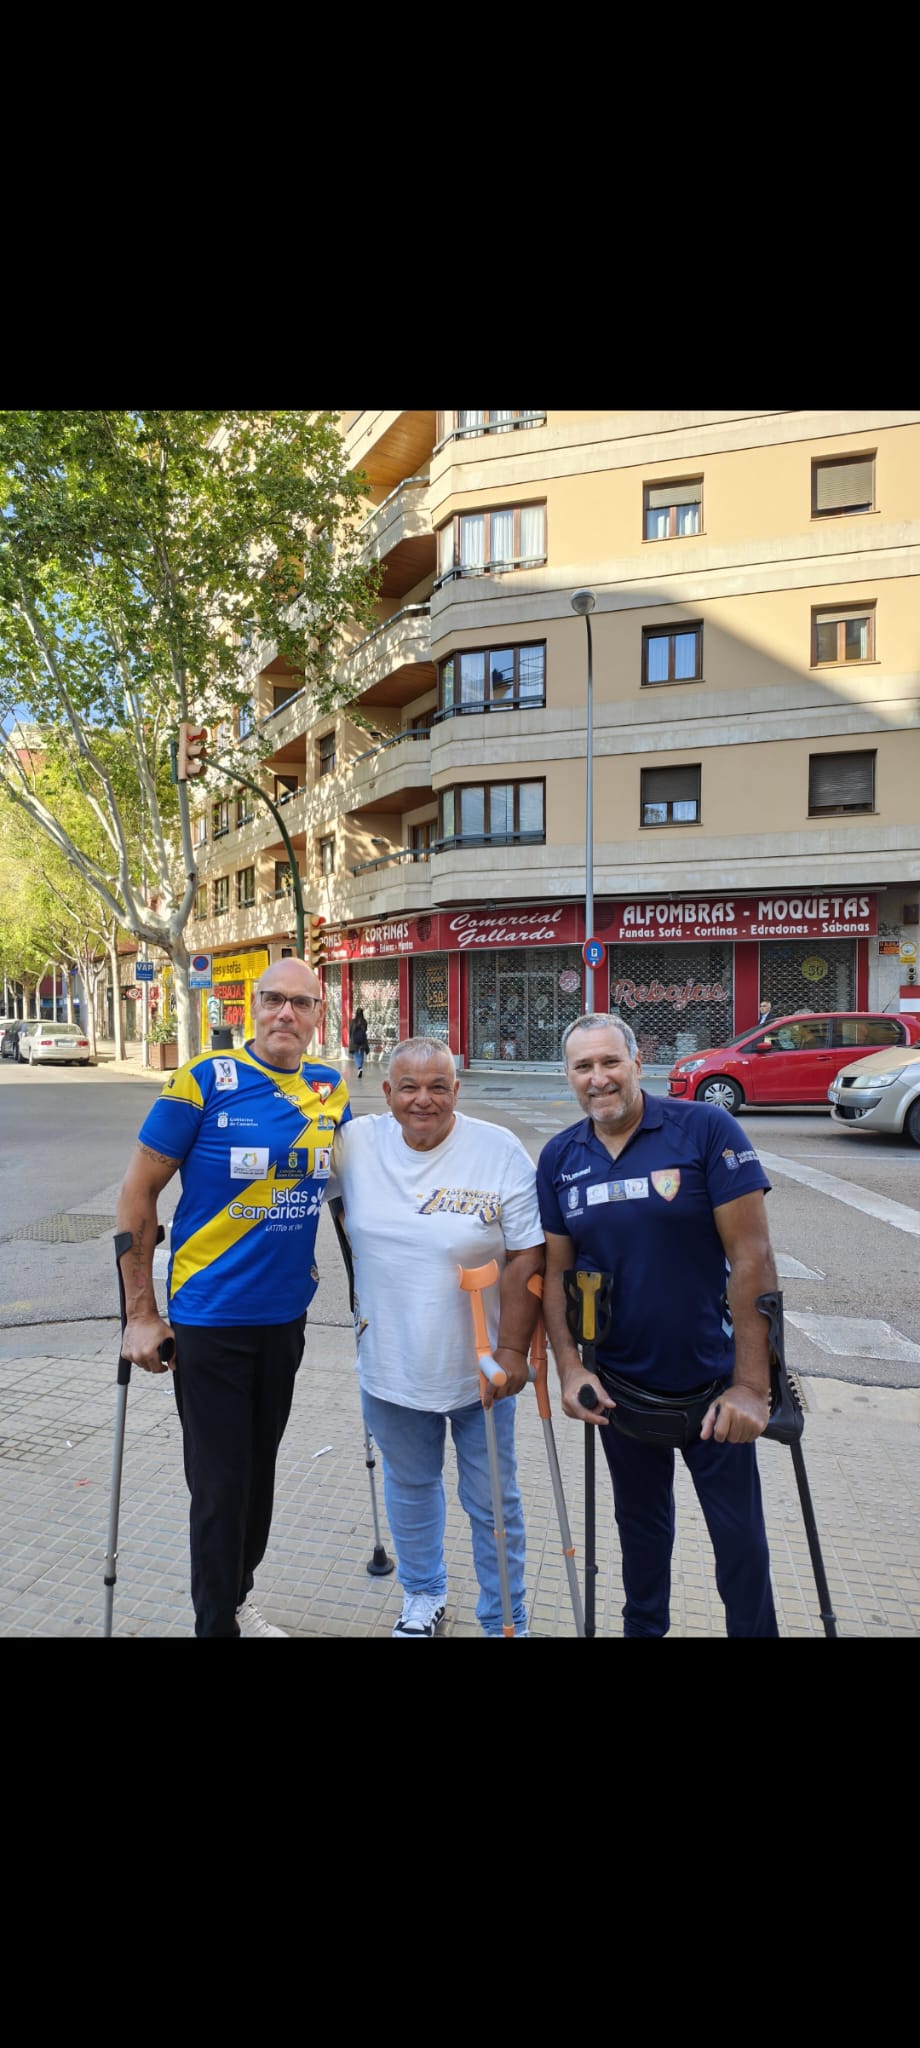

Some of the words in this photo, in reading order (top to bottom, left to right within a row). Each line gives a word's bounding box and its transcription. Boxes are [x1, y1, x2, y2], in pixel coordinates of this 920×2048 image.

[450, 908, 563, 931] Comercial
[623, 902, 735, 926] ALFOMBRAS
[758, 897, 870, 920] MOQUETAS
[365, 922, 409, 943] CORTINAS
[457, 926, 556, 948] Gallardo
[619, 928, 655, 938] Fundas
[658, 925, 682, 937] Sofá
[694, 926, 738, 936] Cortinas
[750, 923, 808, 935] Edredones
[822, 919, 870, 933] Sábanas
[136, 964, 153, 972] VAP
[610, 978, 728, 1010] Rebajas
[272, 1187, 308, 1204] Islas
[229, 1202, 306, 1219] Canarias
